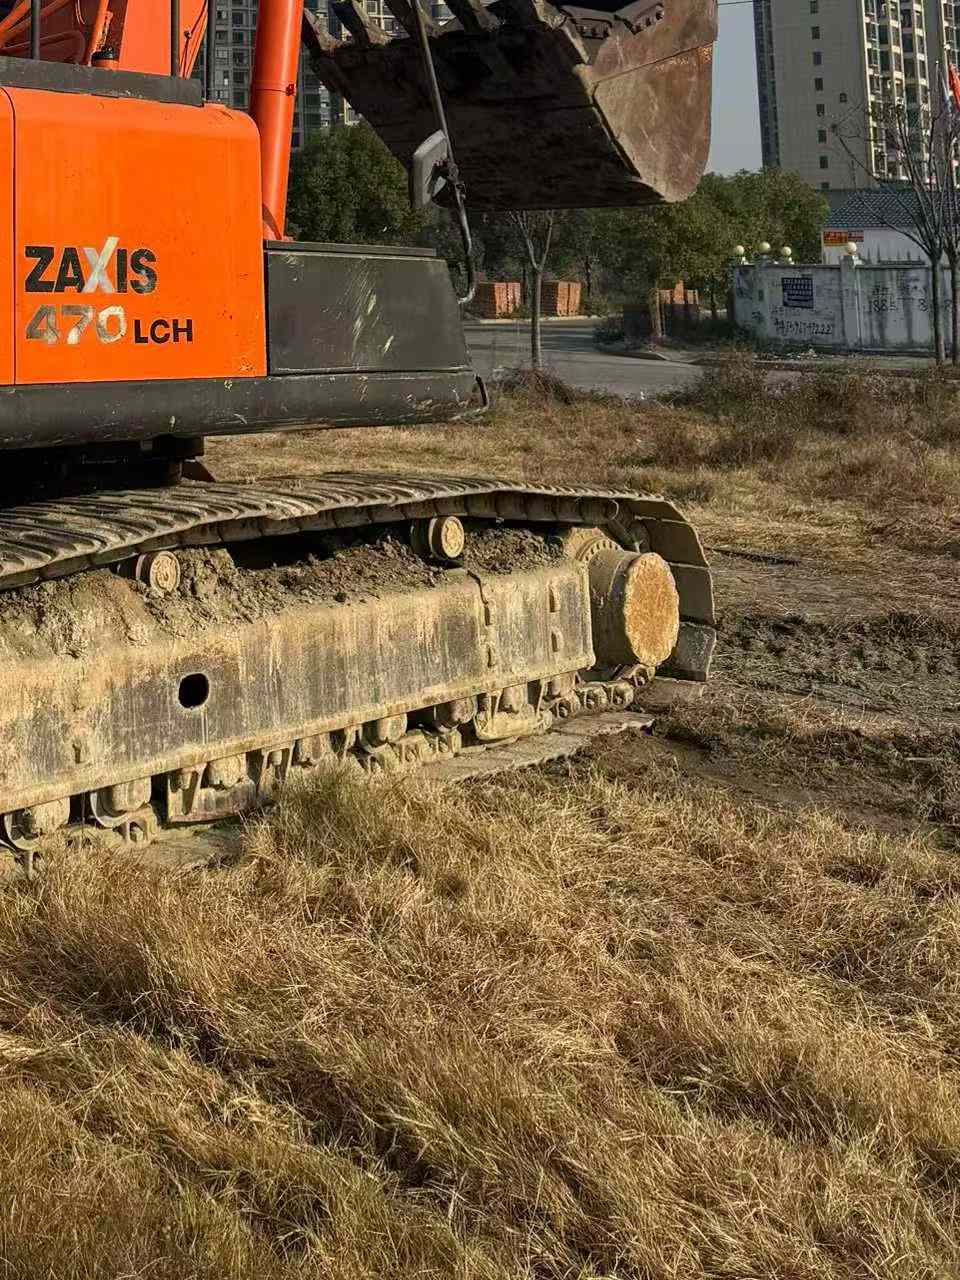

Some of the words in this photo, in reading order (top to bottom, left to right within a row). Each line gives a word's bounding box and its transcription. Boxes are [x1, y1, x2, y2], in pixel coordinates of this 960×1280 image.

[25, 237, 158, 294] ZAXIS
[25, 305, 126, 345] 470
[134, 319, 193, 344] LCH
